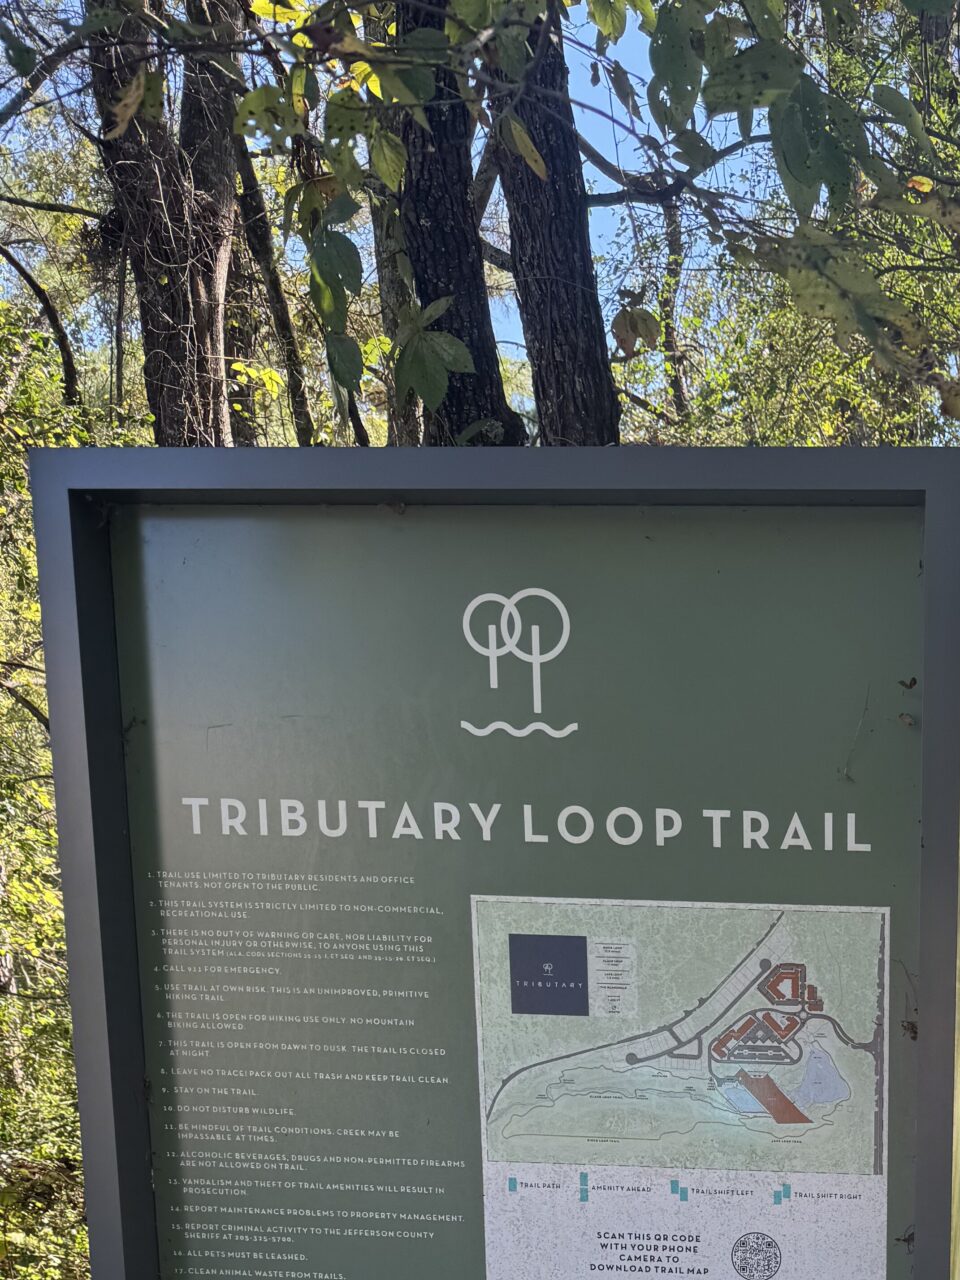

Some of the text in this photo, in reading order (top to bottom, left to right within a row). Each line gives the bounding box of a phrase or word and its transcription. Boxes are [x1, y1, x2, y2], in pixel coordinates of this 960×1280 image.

[183, 798, 871, 851] TRIBUTARY LOOP TRAIL
[157, 870, 182, 878] TRAIL
[184, 871, 200, 879] USE
[202, 871, 239, 880] LIMITED
[241, 872, 254, 880] TO
[255, 872, 305, 881] TRIBUTARY
[307, 873, 358, 882] RESIDENTS
[380, 875, 414, 883] OFFICE
[159, 880, 202, 888] TENANTS.
[224, 881, 249, 889] OPEN
[251, 882, 263, 890] TO
[266, 882, 282, 890] THE
[284, 883, 320, 891] PUBLIC.
[162, 964, 185, 972] CALL
[204, 965, 222, 973] FOR
[223, 965, 282, 974] EMERGENCY.
[515, 980, 583, 989] TRIBUTARY
[166, 1011, 183, 1019] THE
[212, 1012, 220, 1020] IS
[221, 1012, 247, 1021] OPEN
[248, 1013, 266, 1021] FOR
[268, 1014, 301, 1022] HIKING
[302, 1015, 319, 1023] USE
[365, 1017, 414, 1026] MOUNTAIN
[168, 1039, 188, 1047] THIS
[189, 1040, 214, 1048] TRAIL
[226, 1041, 251, 1049] OPEN
[309, 1043, 321, 1051] TO
[351, 1045, 368, 1053] THE
[408, 1047, 446, 1055] CLOSED
[171, 1067, 198, 1075] LEAVE
[215, 1068, 247, 1077] TRACE!
[274, 1070, 292, 1078] OUT
[313, 1072, 342, 1080] TRASH
[365, 1073, 388, 1081] KEEP
[390, 1074, 415, 1082] TRAIL
[230, 1087, 259, 1095] TRAIL.
[176, 1104, 296, 1115] DO NOT DISTURB WILDLIFE.
[178, 1122, 189, 1130] BE
[190, 1123, 230, 1131] MINDFUL
[232, 1124, 244, 1132] OF
[246, 1125, 272, 1133] TRAIL
[273, 1126, 334, 1135] CONDITIONS.
[336, 1128, 366, 1136] CREEK
[388, 1130, 399, 1138] BE
[177, 1132, 277, 1142] IMPASSABLE AT TIMES.
[179, 1150, 465, 1167] ALCOHOLIC BEVERAGES, DRUGS AND NON-PERMITTED FIREARMS
[197, 1159, 216, 1167] NOT
[218, 1160, 262, 1169] ALLOWED
[278, 1162, 307, 1170] TRAIL.
[181, 1177, 232, 1186] VANDALISM
[234, 1179, 252, 1187] AND
[254, 1179, 282, 1187] THEFT
[298, 1181, 324, 1189] TRAIL
[325, 1182, 374, 1191] AMENITIES
[400, 1185, 433, 1193] RESULT
[183, 1204, 218, 1212] REPORT
[219, 1206, 284, 1215] MAINTENANCE
[286, 1208, 334, 1217] PROBLEMS
[350, 1210, 397, 1219] PROPERTY
[399, 1212, 464, 1222] MANAGEMENT.
[184, 1222, 219, 1230] REPORT
[220, 1224, 264, 1232] CRIMINAL
[266, 1225, 308, 1234] ACTIVITY
[323, 1227, 341, 1235] THE
[343, 1228, 394, 1237] JEFFERSON
[395, 1230, 434, 1239] COUNTY
[184, 1231, 220, 1239] SHERIFF
[222, 1232, 232, 1240] AT
[596, 1231, 701, 1242] SCAN THIS QR CODE
[599, 1242, 698, 1253] WITH YOUR PHONE
[204, 1249, 226, 1257] PETS
[227, 1250, 250, 1258] MUST
[252, 1251, 263, 1259] BE
[265, 1252, 308, 1261] LEASHED.
[618, 1253, 679, 1263] CAMERA TO
[187, 1267, 217, 1275] CLEAN
[219, 1268, 252, 1276] ANIMAL
[254, 1269, 283, 1277] WASTE
[312, 1272, 346, 1280] TRAILS.
[589, 1263, 709, 1275] DOWNLOAD TRAIL MAP
